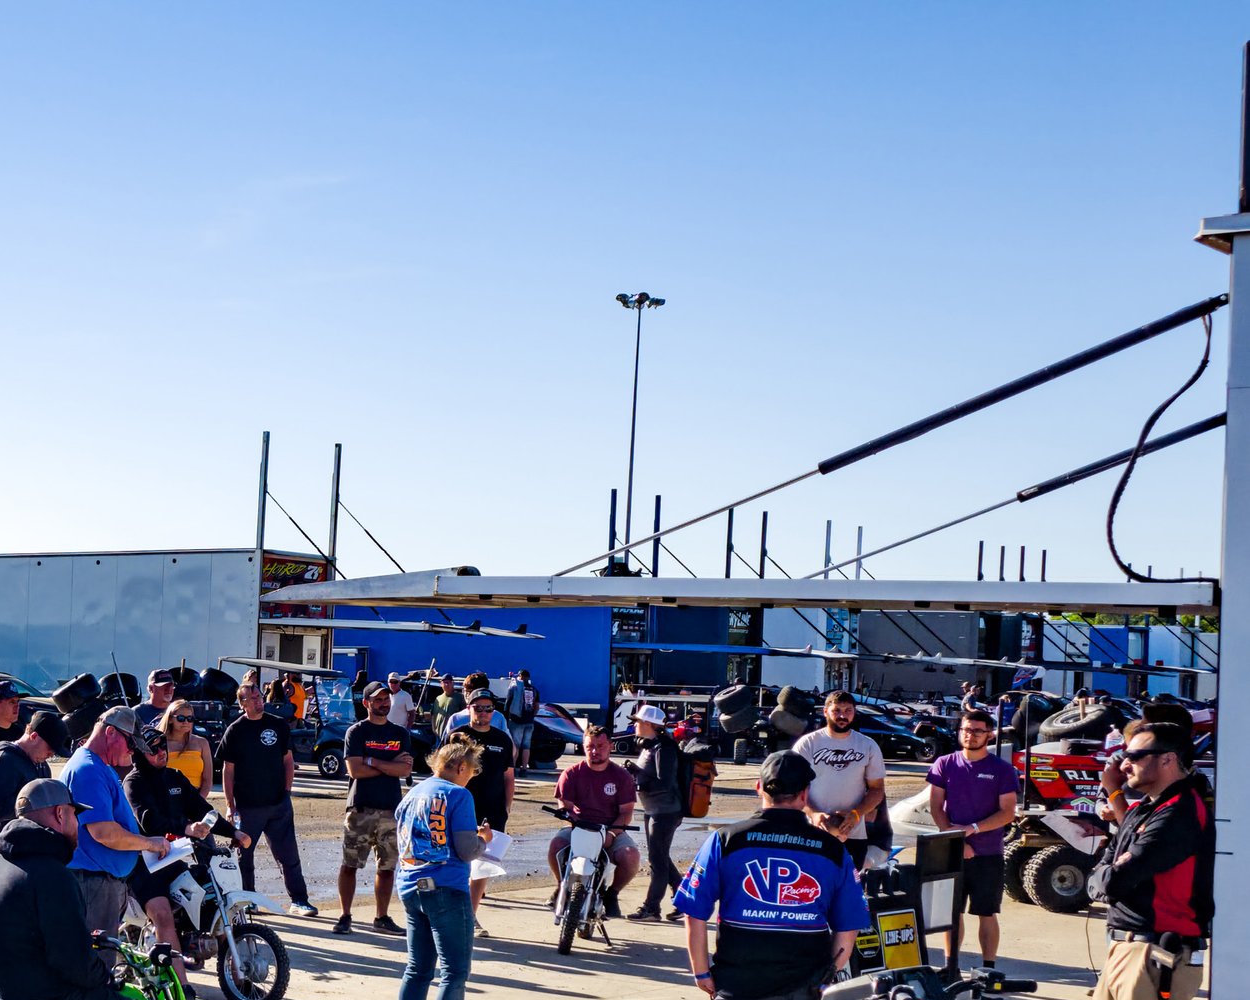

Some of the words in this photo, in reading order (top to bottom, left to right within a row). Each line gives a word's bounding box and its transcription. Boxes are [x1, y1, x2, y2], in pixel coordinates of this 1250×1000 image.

[813, 748, 865, 767] Marlar
[747, 831, 823, 849] VPRacingFuels.com
[746, 857, 801, 906] VP
[781, 885, 818, 899] Racing
[742, 909, 780, 919] MAKIN'
[781, 911, 818, 921] POWER!
